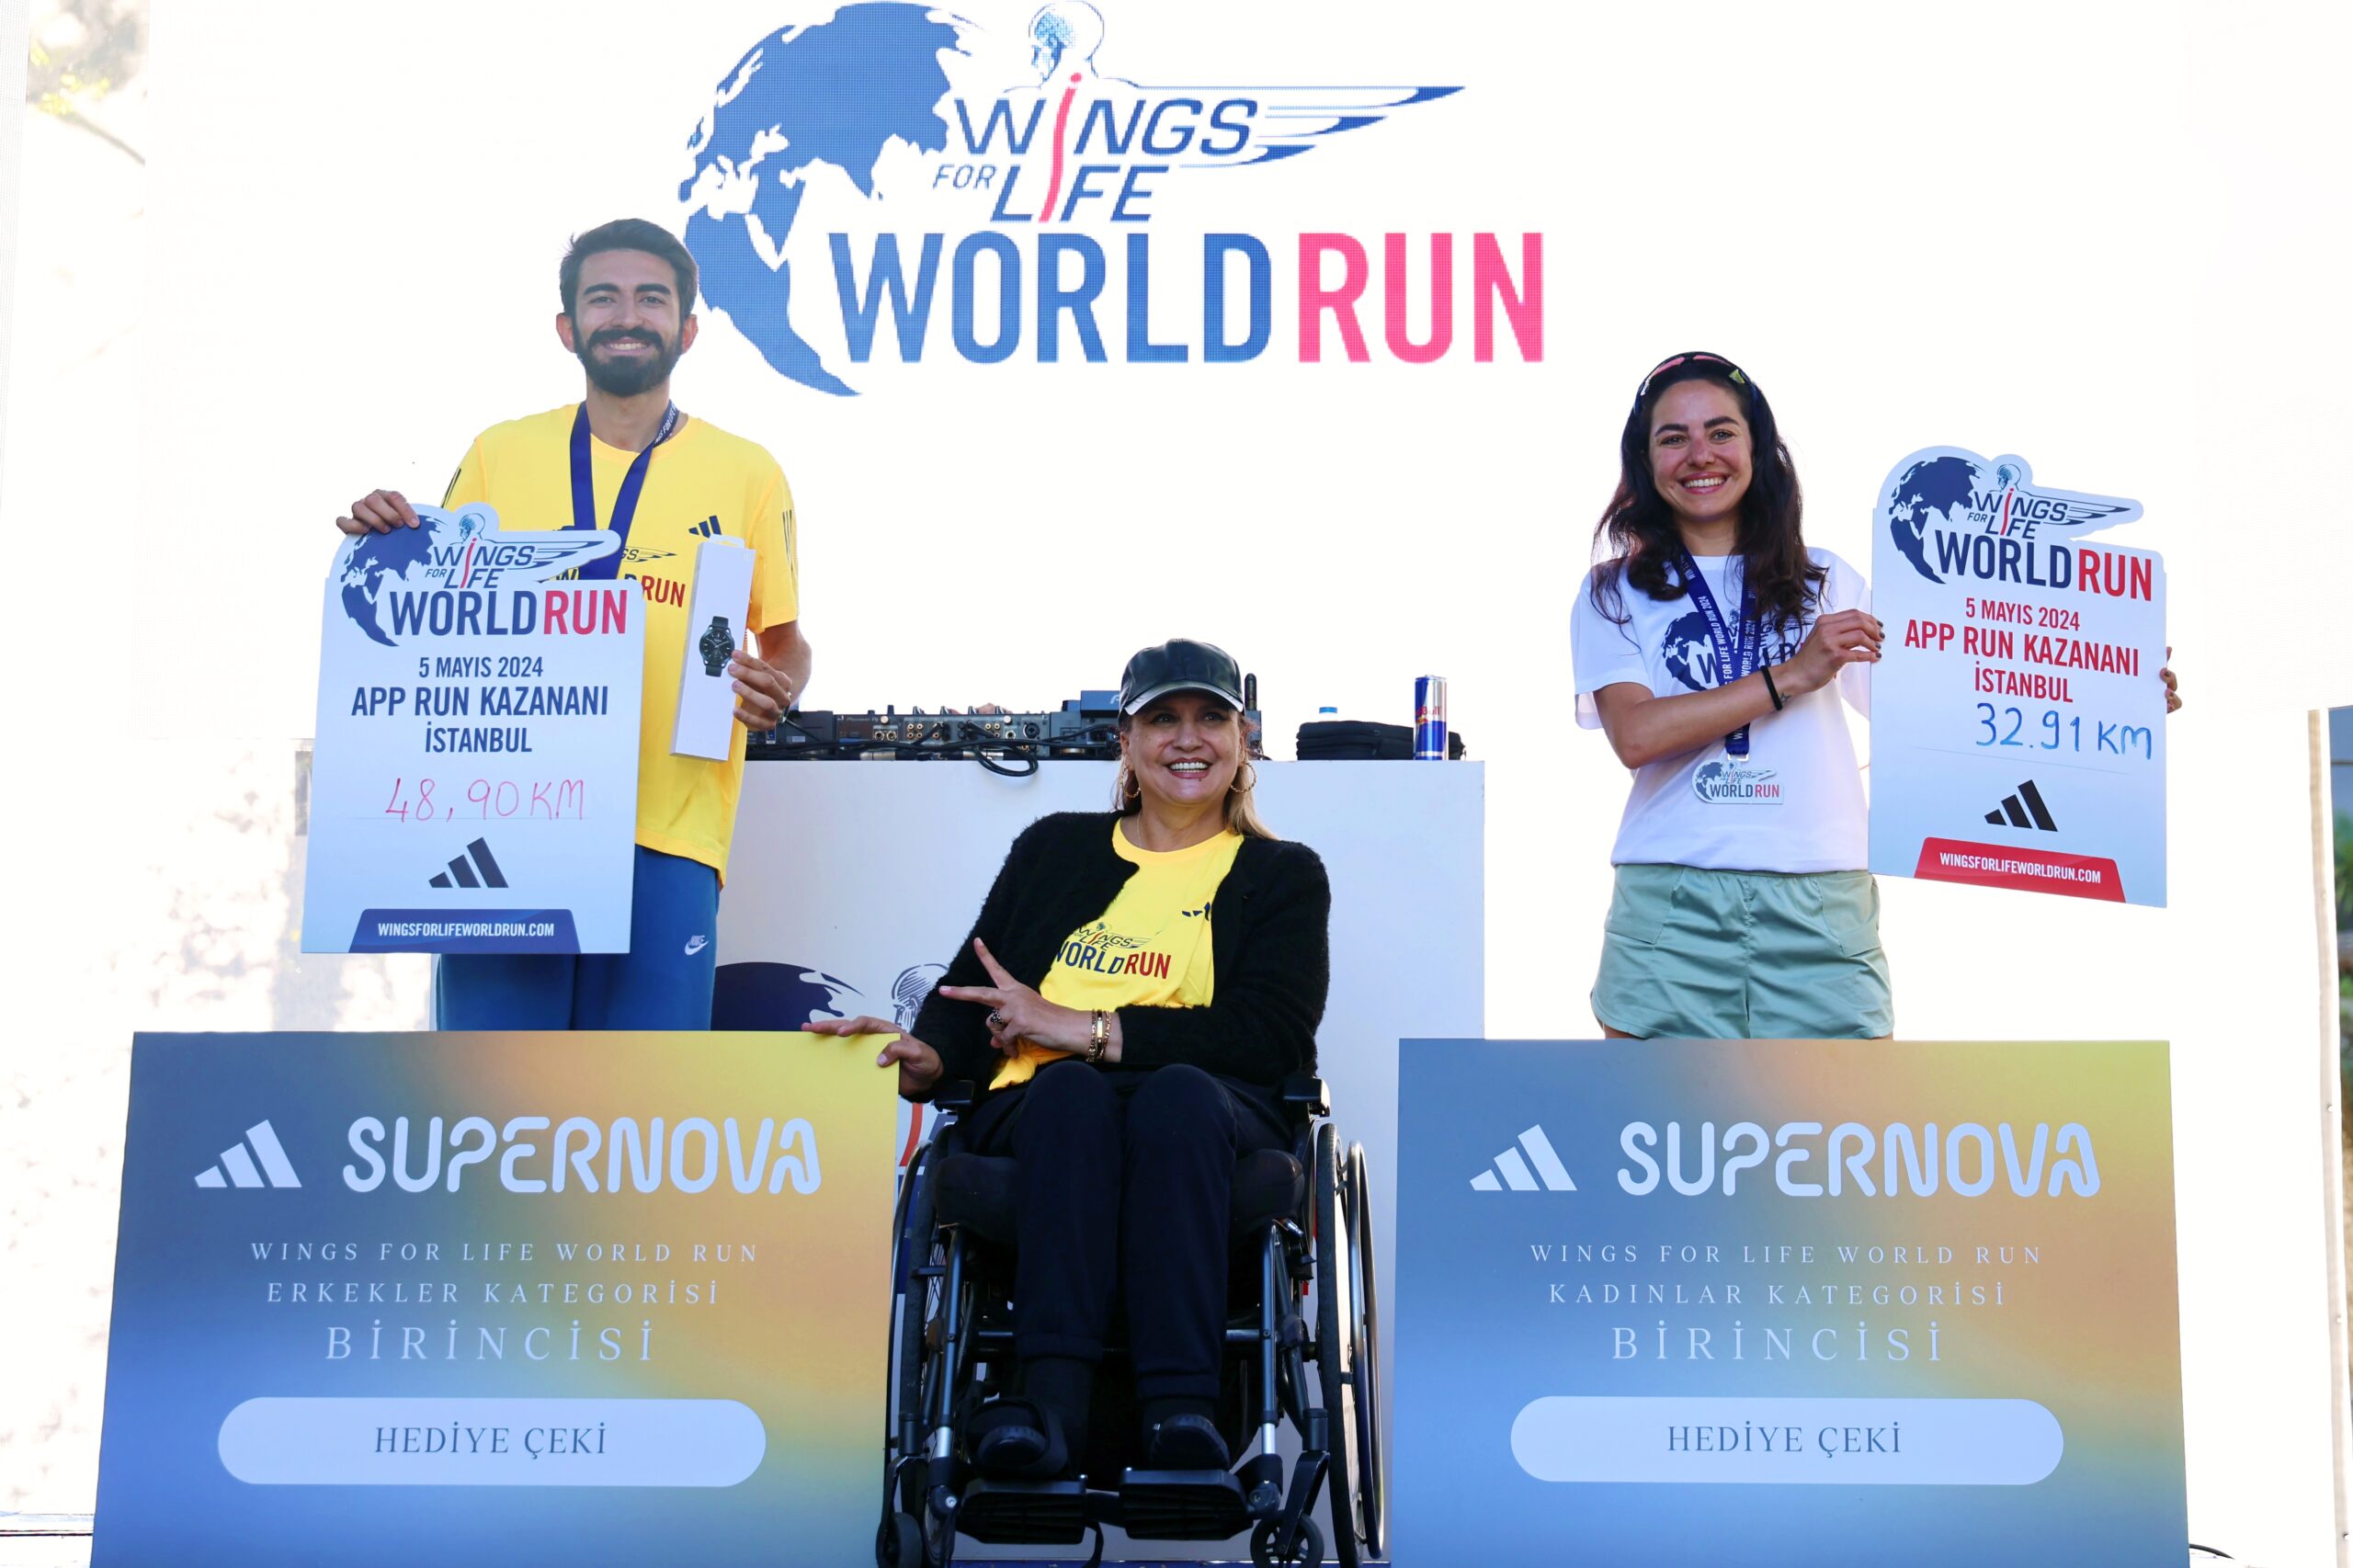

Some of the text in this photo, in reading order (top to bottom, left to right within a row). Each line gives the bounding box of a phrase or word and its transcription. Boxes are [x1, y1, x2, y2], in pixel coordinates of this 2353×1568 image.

[932, 164, 996, 190] FOR
[828, 231, 1544, 363] WORLD RUN
[1967, 512, 1987, 523] FOR
[425, 568, 448, 578] FOR
[1935, 529, 2152, 602] WORLD RUN
[641, 574, 686, 608] RUN
[1698, 596, 1712, 613] 2024
[390, 589, 628, 636] WORLD RUN
[1705, 609, 1718, 625] RUN
[1965, 597, 2081, 631] 5 MAYIS 2024
[1711, 623, 1727, 646] WORLD
[1904, 619, 2139, 677] APP RUN KAZANANI
[418, 656, 544, 677] 5 MAYIS 2024
[1719, 645, 1732, 665] LIFE
[1741, 651, 1754, 677] WORLD
[1723, 664, 1734, 683] FOR
[1975, 660, 2074, 703] İSTANBUL
[351, 686, 608, 717] APP RUN KAZANANI
[425, 722, 532, 753] İSTANBUL
[1976, 702, 2080, 752] 32.91
[1710, 784, 1779, 798] WORLD RUN
[1939, 852, 2101, 884] WINGSFORLIFEWORLDRUN.COM
[378, 922, 554, 937] WINGSFORLIFEWORLDRUN.COM
[1123, 951, 1172, 980] RUN
[342, 1115, 822, 1195] SUPERNOVA
[1618, 1121, 2100, 1197] SUPERNOVA
[251, 1242, 757, 1262] WINGS FOR LIFE WORLD RUN
[1530, 1244, 2042, 1265] WINGS FOR LIFE WORLD RUN
[267, 1278, 719, 1304] ERKEKLER KATEGORİSİ
[1549, 1280, 2006, 1305] KADINLAR KATEGORİSİ
[325, 1319, 653, 1360] BİRİNCİSİ
[1612, 1321, 1941, 1361] BİRİNCİSİ
[374, 1419, 607, 1460] HEDİYE ÇEKİ
[1666, 1419, 1901, 1458] HEDİYE ÇEKİ
